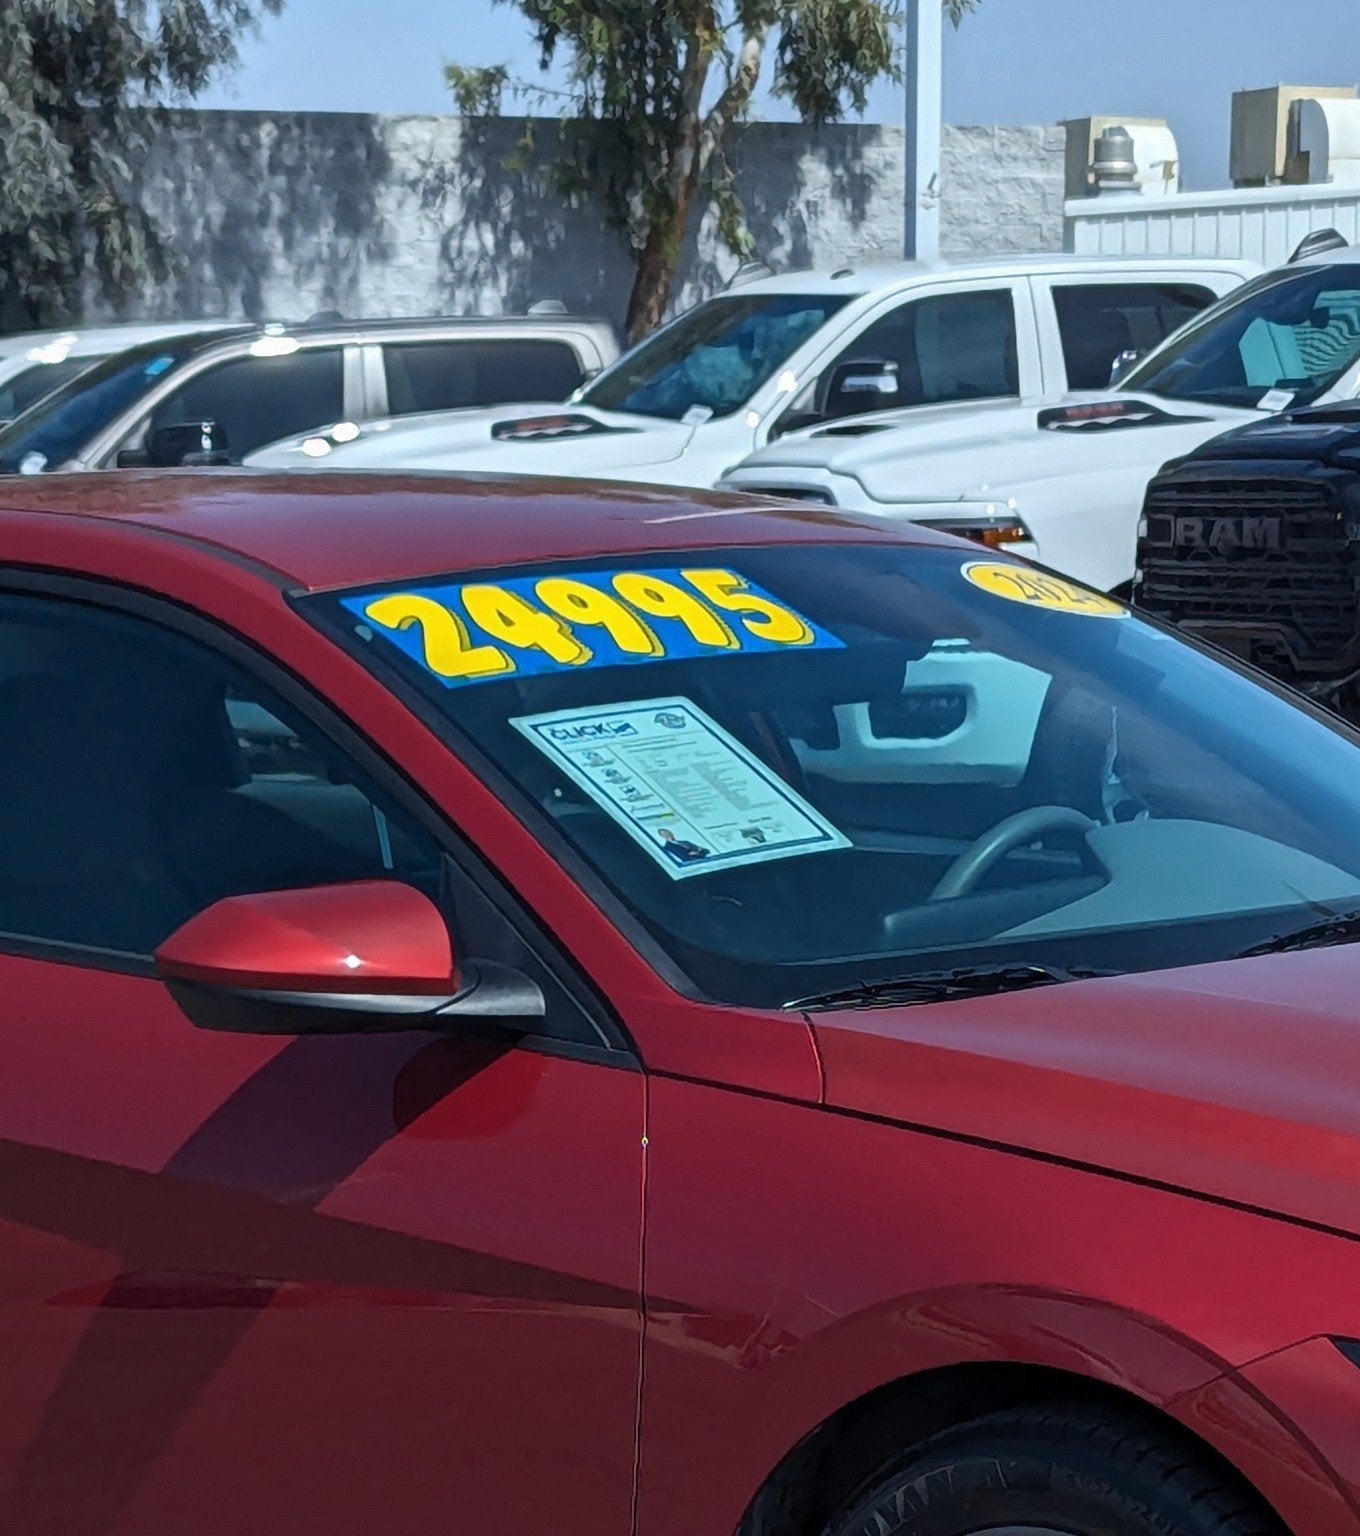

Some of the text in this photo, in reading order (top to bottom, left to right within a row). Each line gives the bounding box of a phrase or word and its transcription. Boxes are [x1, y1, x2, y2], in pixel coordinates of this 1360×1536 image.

[1175, 516, 1281, 548] RAM
[365, 568, 815, 677] 24995
[550, 722, 611, 741] CLICK
